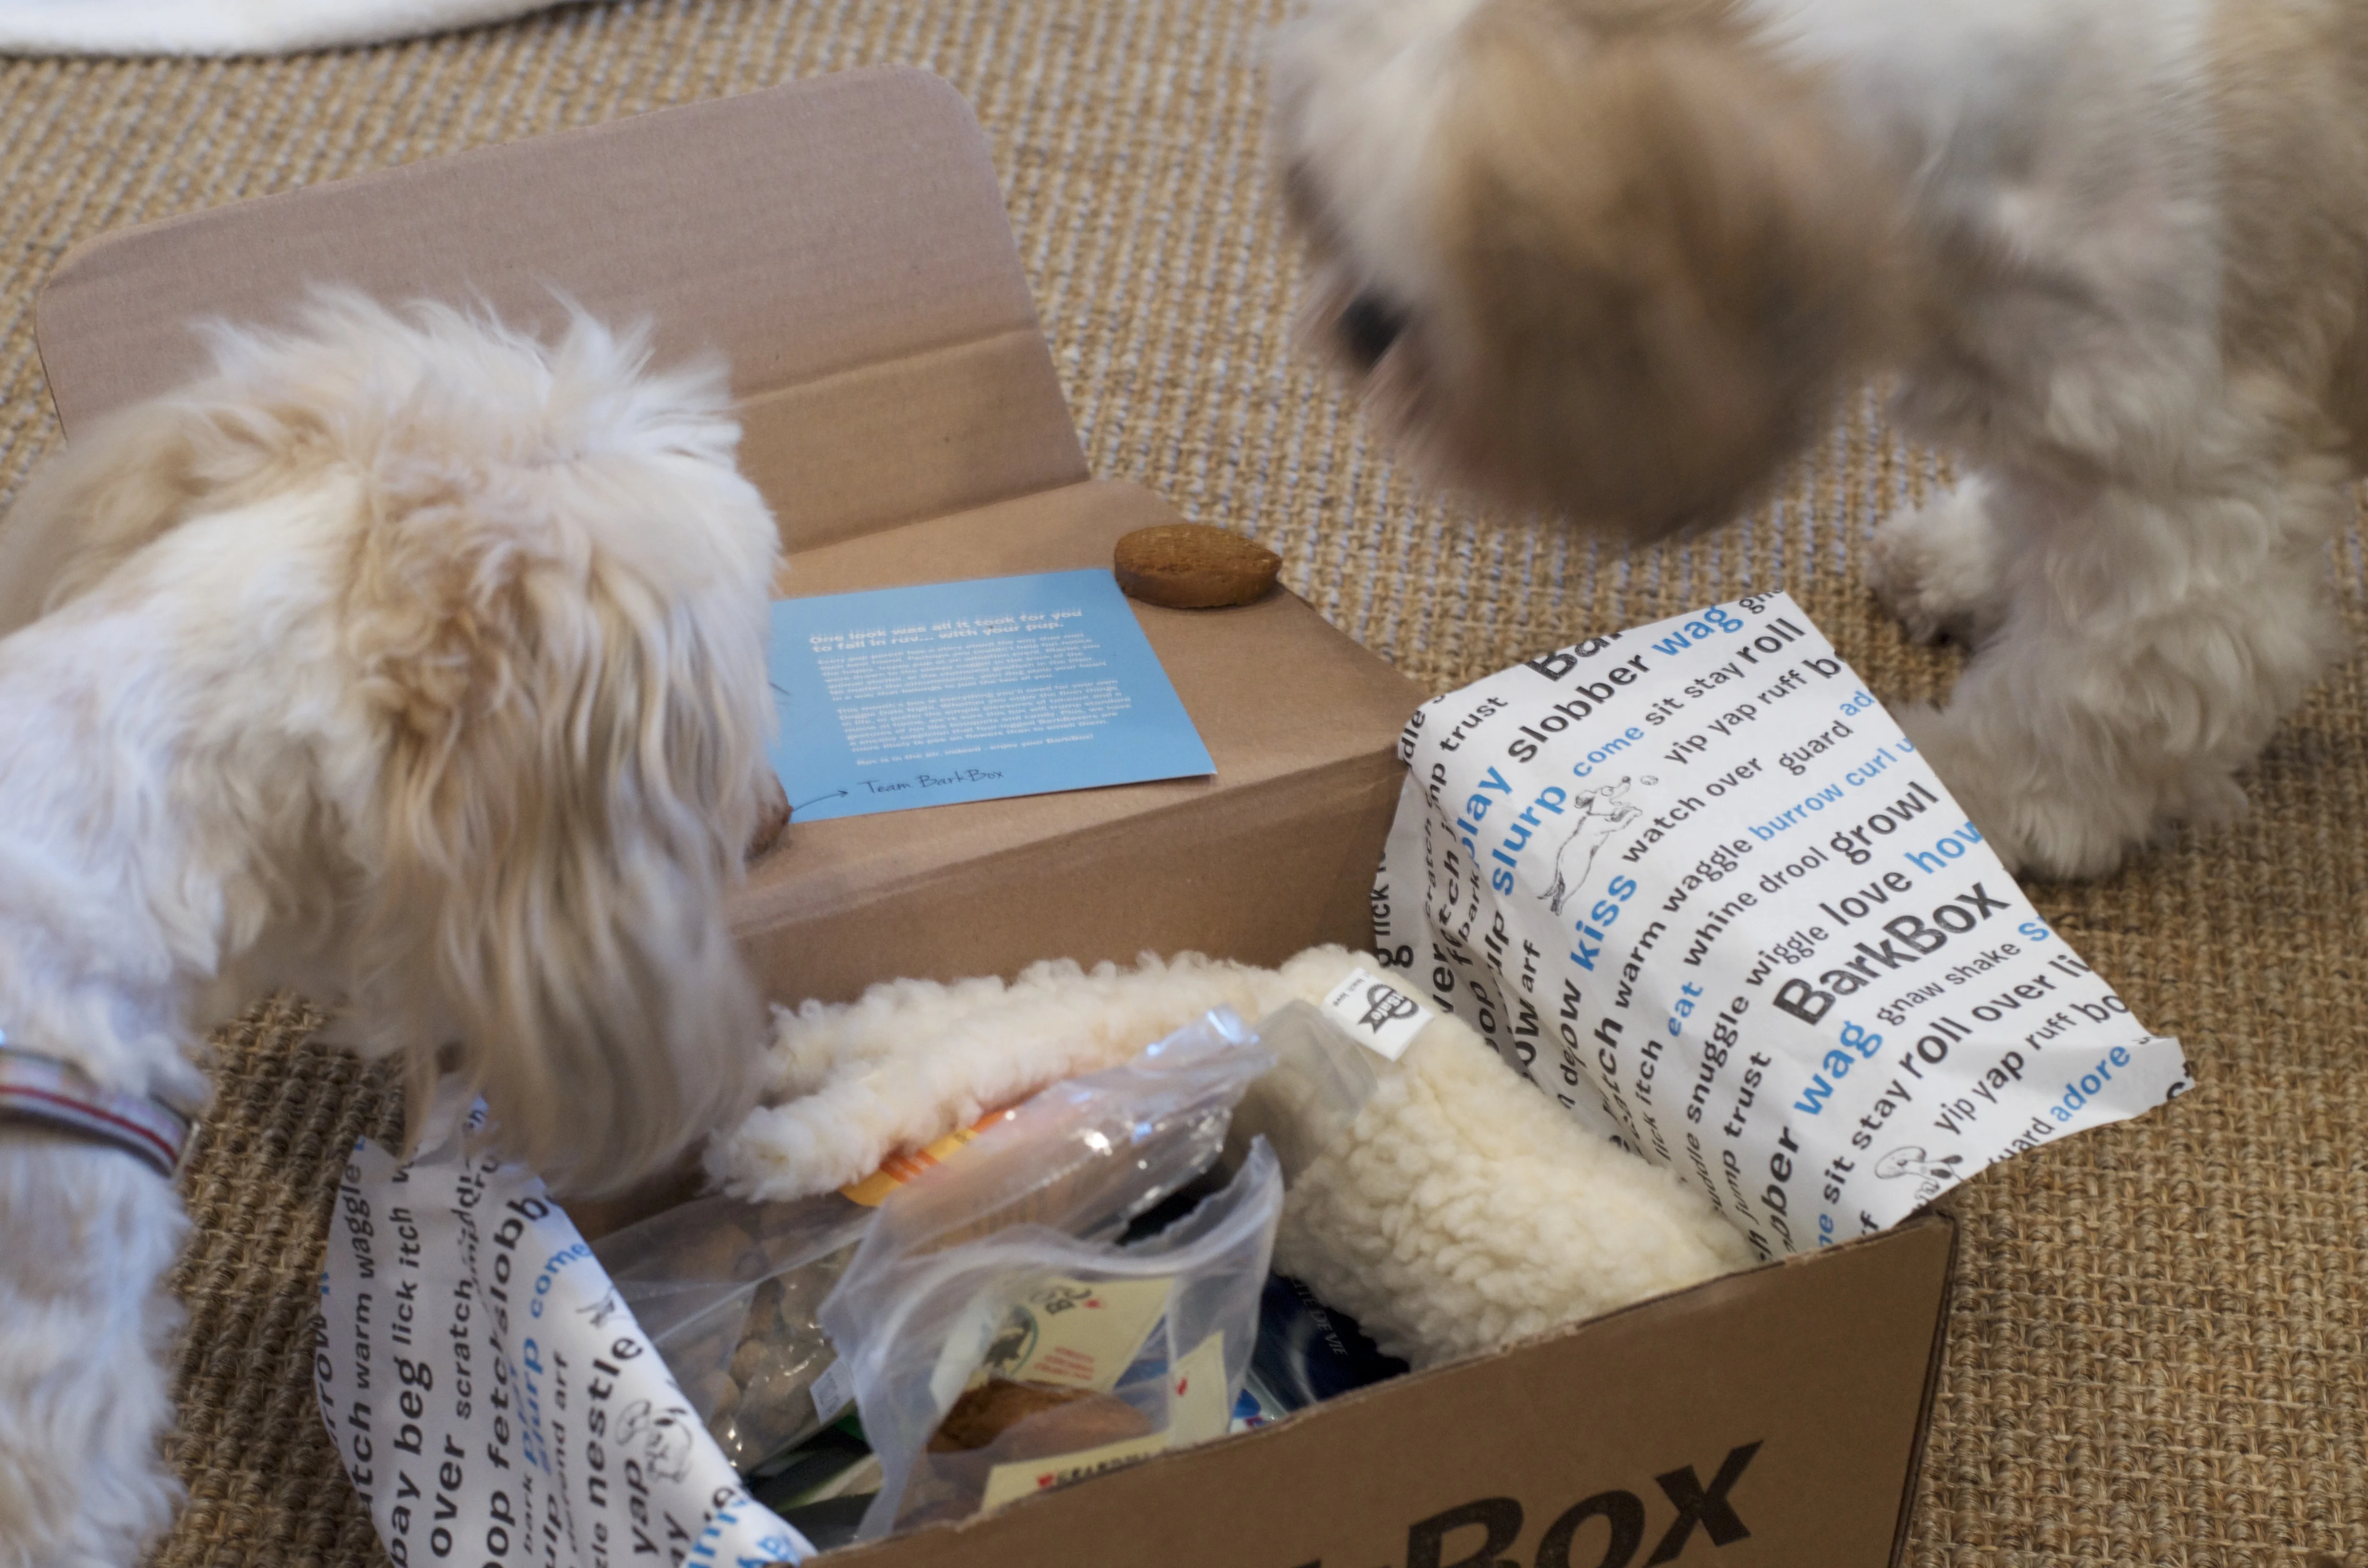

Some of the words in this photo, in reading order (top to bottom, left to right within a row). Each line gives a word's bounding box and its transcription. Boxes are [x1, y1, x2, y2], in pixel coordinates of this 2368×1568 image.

[808, 635, 844, 644] One
[847, 629, 888, 639] look
[890, 626, 927, 635] was
[930, 623, 952, 631] all
[974, 617, 1014, 626] took
[1018, 613, 1046, 622] for
[1050, 611, 1083, 620] you
[1439, 696, 1508, 752] trust
[1508, 654, 1651, 764] slobber
[1652, 604, 1744, 657] wag
[1573, 726, 1645, 777] come
[1645, 697, 1685, 726] sit
[1684, 662, 1746, 698] stay
[1736, 618, 1806, 664] roll
[1664, 733, 1708, 765] yip
[1707, 703, 1758, 736] yap
[1757, 669, 1808, 705] ruff
[857, 780, 912, 794] Team
[1457, 766, 1513, 868] play
[1622, 796, 1706, 863] watch
[1706, 757, 1763, 797] over
[1778, 720, 1854, 776] guard
[1830, 780, 1940, 866] growl
[1492, 785, 1567, 896] slurp
[1615, 920, 1667, 1009] warm
[1662, 837, 1753, 913] waggle
[1748, 783, 1845, 842] burrow
[1846, 747, 1898, 787] curl
[1759, 845, 1830, 894] drool
[1521, 939, 1541, 993] arf
[1569, 875, 1638, 973] kiss
[1683, 891, 1758, 968] whine
[1772, 881, 2013, 1027] BarkBox
[1668, 981, 1704, 1037] eat
[1687, 995, 1750, 1125] snuggle
[1745, 925, 1830, 987] wiggle
[1818, 871, 1913, 927] love
[1793, 1020, 1883, 1116] wag
[1877, 982, 1946, 1027] gnaw
[1945, 941, 2021, 986] shake
[1635, 1039, 1664, 1106] itch
[1723, 1051, 1772, 1139] trust
[1824, 1155, 1856, 1205] sit
[1851, 1078, 1912, 1151] stay
[1898, 1016, 1973, 1080] roll
[1971, 973, 2057, 1023] over
[1934, 1097, 1977, 1135] yip
[1972, 1050, 2025, 1104] yap
[2024, 1012, 2077, 1051] ruff
[2050, 1045, 2131, 1122] adore
[339, 1163, 375, 1280] waggle
[1722, 1150, 1760, 1226] jump
[388, 1206, 421, 1269] itch
[530, 1242, 592, 1319] come
[355, 1292, 373, 1390] warm
[391, 1280, 418, 1345] lick
[394, 1356, 433, 1456] beg
[431, 1433, 466, 1558] over
[449, 1278, 472, 1420] scratch
[553, 1349, 568, 1412] arf
[587, 1337, 645, 1508] nestle
[390, 1470, 421, 1568] bay
[624, 1457, 660, 1556] yap
